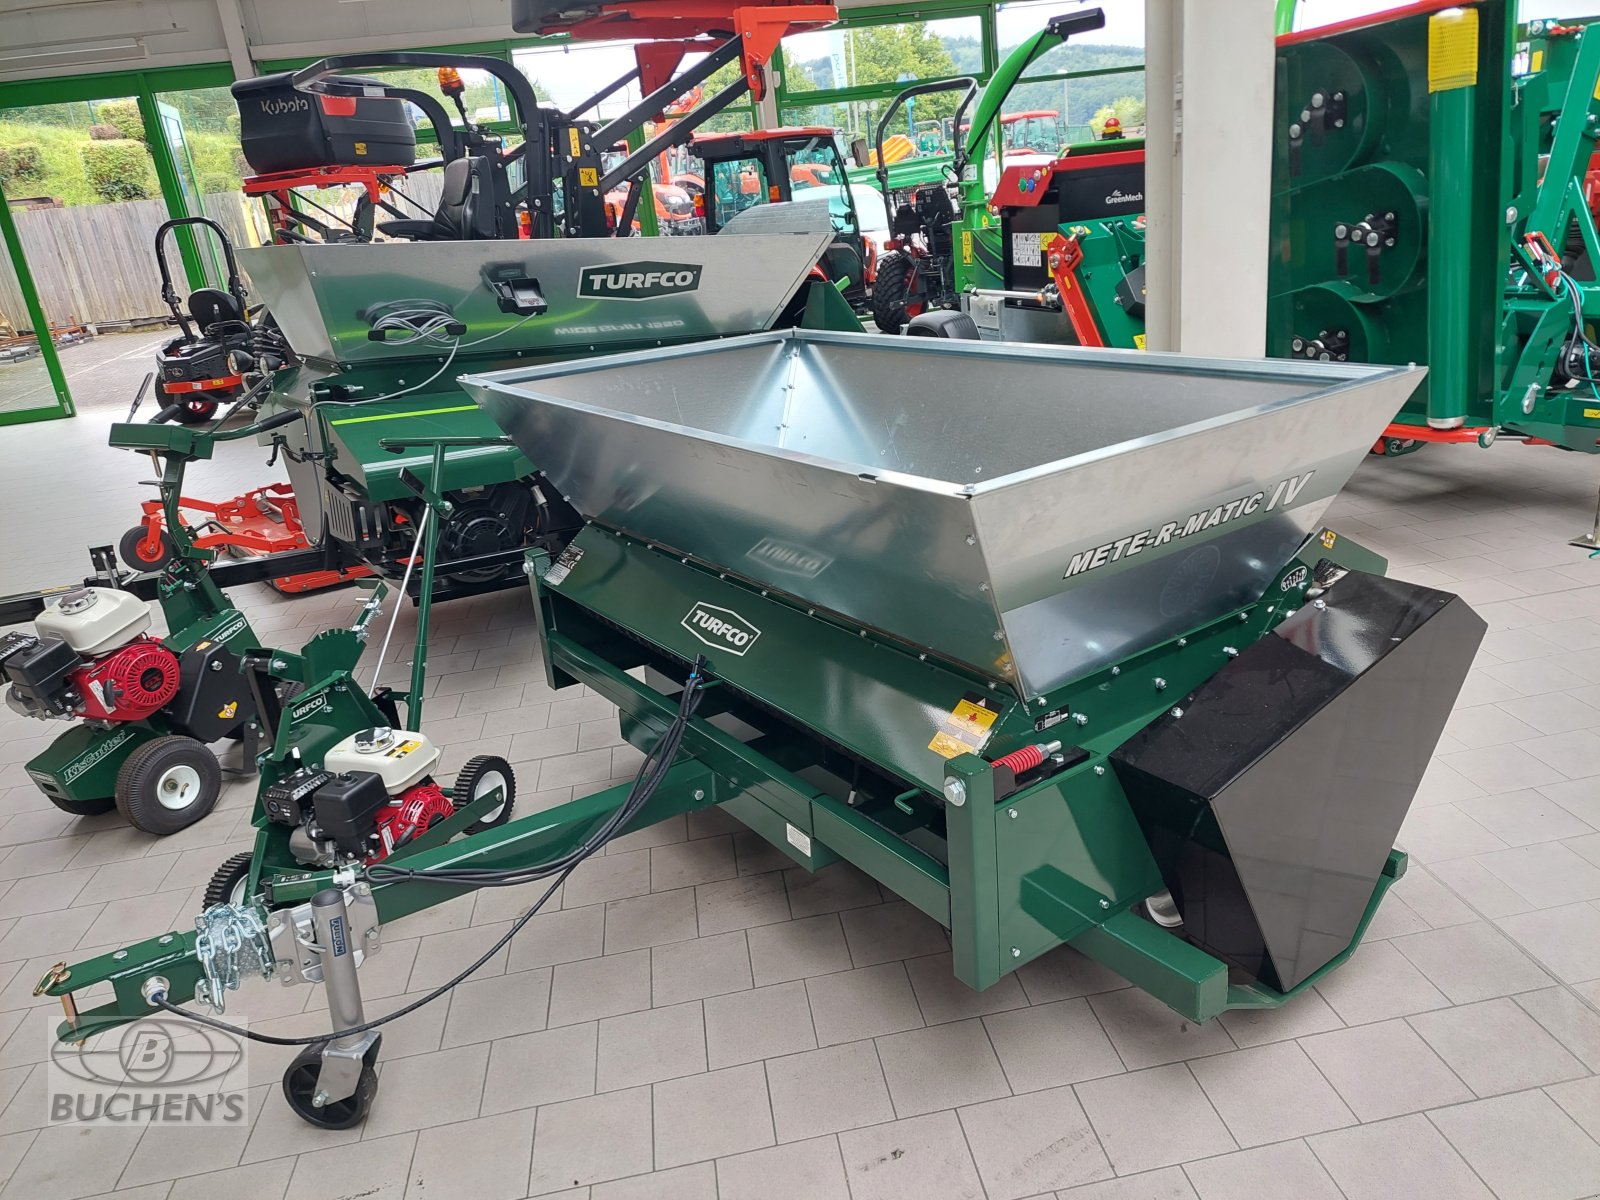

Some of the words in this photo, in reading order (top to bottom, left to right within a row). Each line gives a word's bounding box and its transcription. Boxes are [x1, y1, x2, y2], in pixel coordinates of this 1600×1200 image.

[260, 96, 309, 115] Kubota
[1105, 191, 1143, 204] GreenMech
[588, 270, 694, 291] TURFCO
[1062, 491, 1264, 580] METE-R-MATIC
[1263, 470, 1317, 513] IV
[213, 621, 244, 643] TURFCO
[692, 609, 749, 646] TURFCO
[292, 697, 323, 719] URFCO
[332, 919, 344, 953] FULTON
